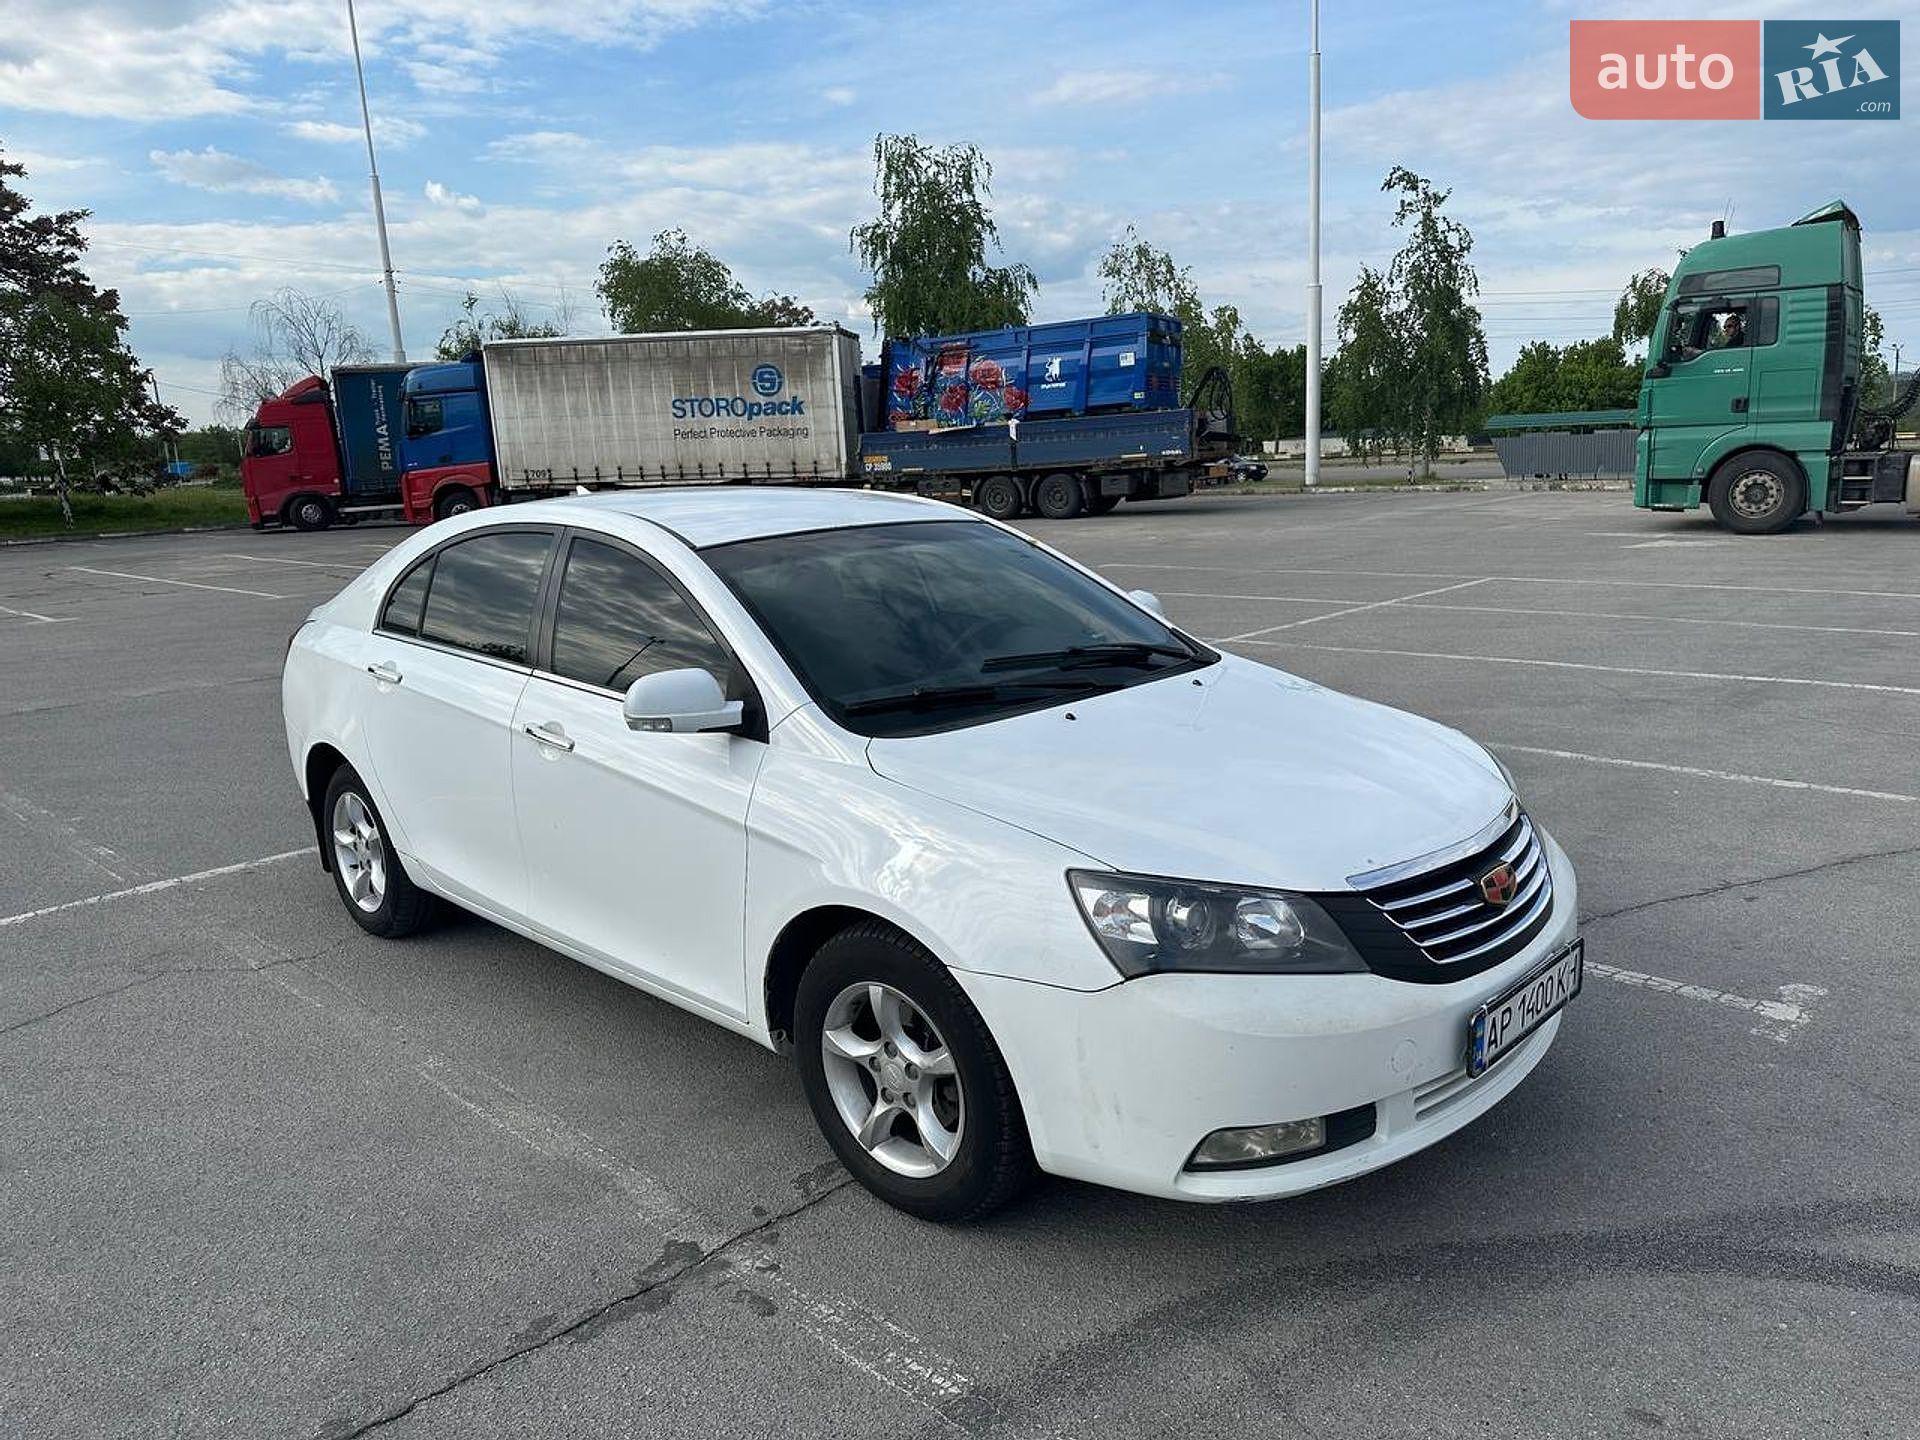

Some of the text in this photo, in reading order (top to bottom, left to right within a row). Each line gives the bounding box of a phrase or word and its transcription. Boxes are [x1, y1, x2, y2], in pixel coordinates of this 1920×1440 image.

[672, 396, 805, 421] STOROpack
[376, 424, 393, 471] PEMA
[673, 426, 809, 440] Perfect Protective Packaging
[1487, 1006, 1512, 1051] AP
[1518, 975, 1554, 1028] 1400
